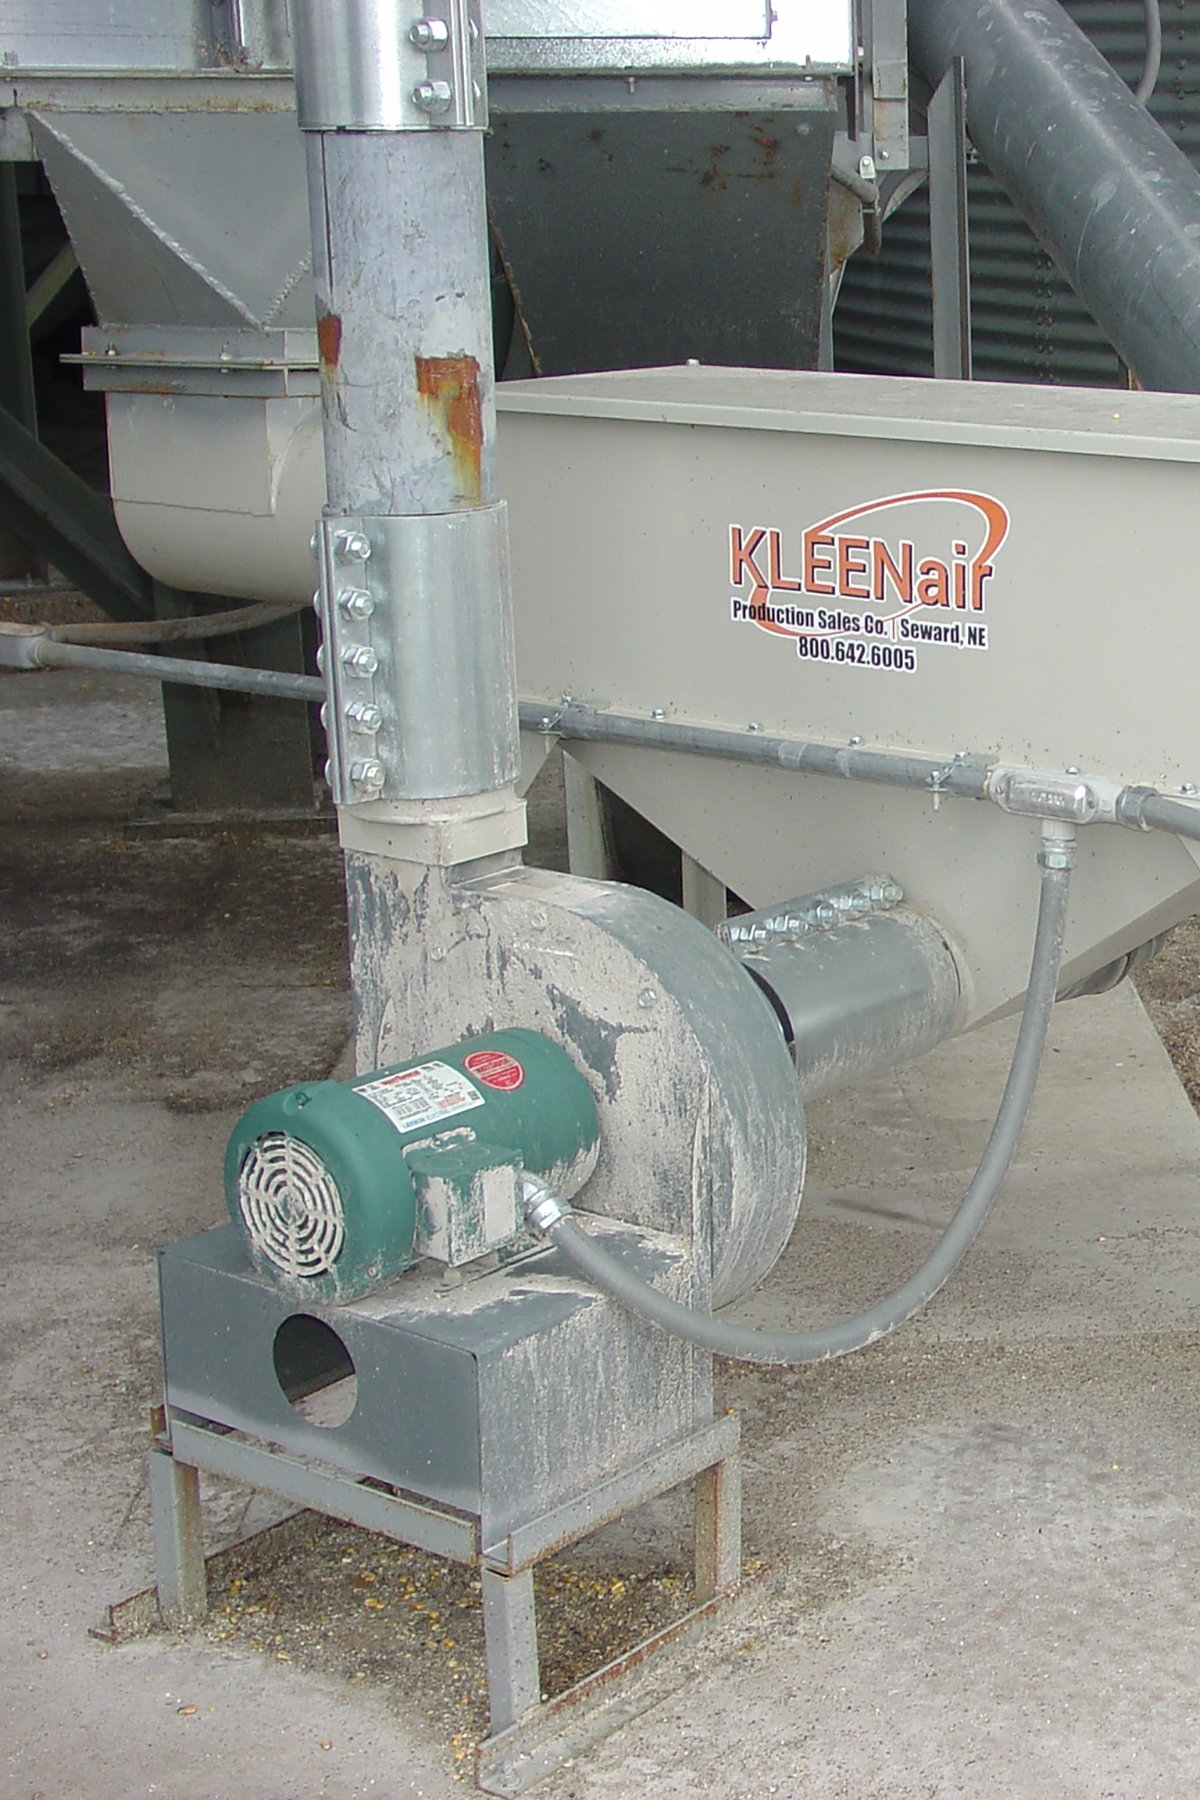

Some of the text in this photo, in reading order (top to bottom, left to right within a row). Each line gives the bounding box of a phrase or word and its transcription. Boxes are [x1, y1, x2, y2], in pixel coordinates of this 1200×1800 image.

[730, 526, 993, 612] KLEENair
[732, 599, 987, 648] Production Sales Co. Seward, NE
[798, 636, 916, 671] 800.642.6005
